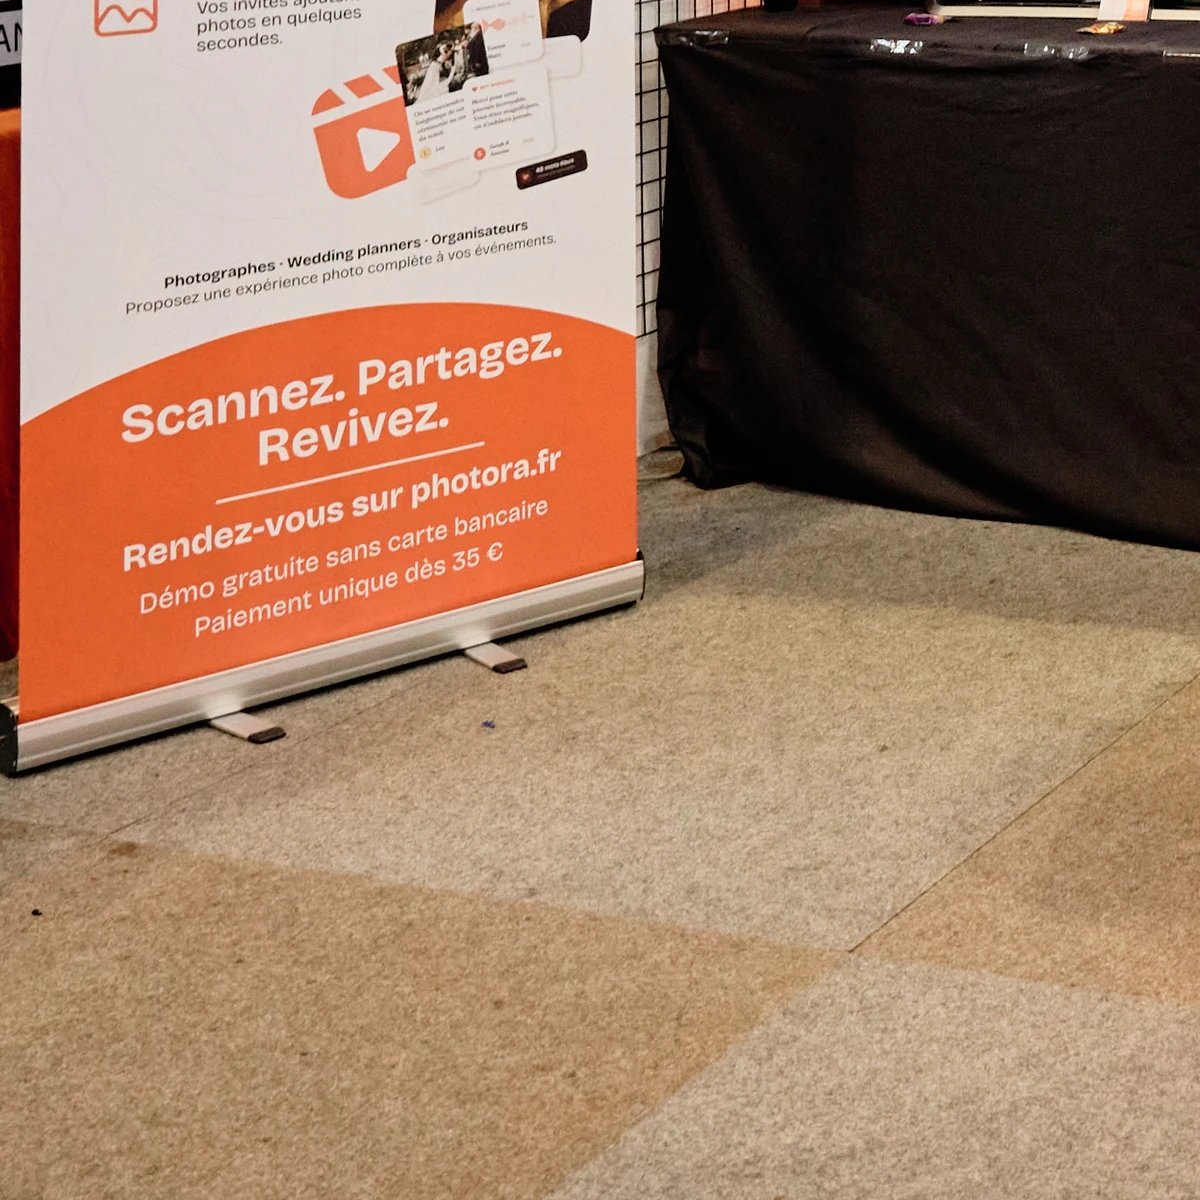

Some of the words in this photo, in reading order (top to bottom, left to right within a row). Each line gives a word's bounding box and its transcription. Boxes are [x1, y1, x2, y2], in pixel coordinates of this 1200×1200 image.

[197, 0, 228, 15] Vos
[197, 16, 256, 34] photos
[260, 15, 281, 28] en
[287, 7, 362, 27] quelques
[197, 32, 282, 52] secondes.
[126, 292, 200, 314] Proposez
[204, 289, 232, 302] une
[236, 271, 319, 297] expérience
[323, 264, 364, 285] photo
[367, 252, 432, 276] complète
[436, 250, 445, 263] à
[448, 246, 471, 261] vos
[476, 234, 557, 256] événements.
[164, 260, 275, 289] Photographes
[287, 247, 355, 269] Wedding
[357, 236, 422, 258] planners
[431, 220, 528, 247] Organisateurs
[122, 373, 345, 442] Scannez.
[358, 331, 563, 395] Partagez.
[258, 400, 449, 466] Revivez.
[124, 502, 345, 571] Rendez-vous
[353, 487, 403, 517] sur
[411, 449, 561, 507] photora.fr
[140, 579, 215, 616] Démo
[223, 553, 320, 597] gratuite
[326, 538, 382, 566] sans
[388, 523, 448, 553] carte
[454, 497, 549, 536] bancaire
[194, 594, 313, 638] Paiement
[319, 572, 398, 604] unique
[404, 559, 446, 584] dès
[452, 551, 481, 572] 35
[487, 542, 503, 563] €
